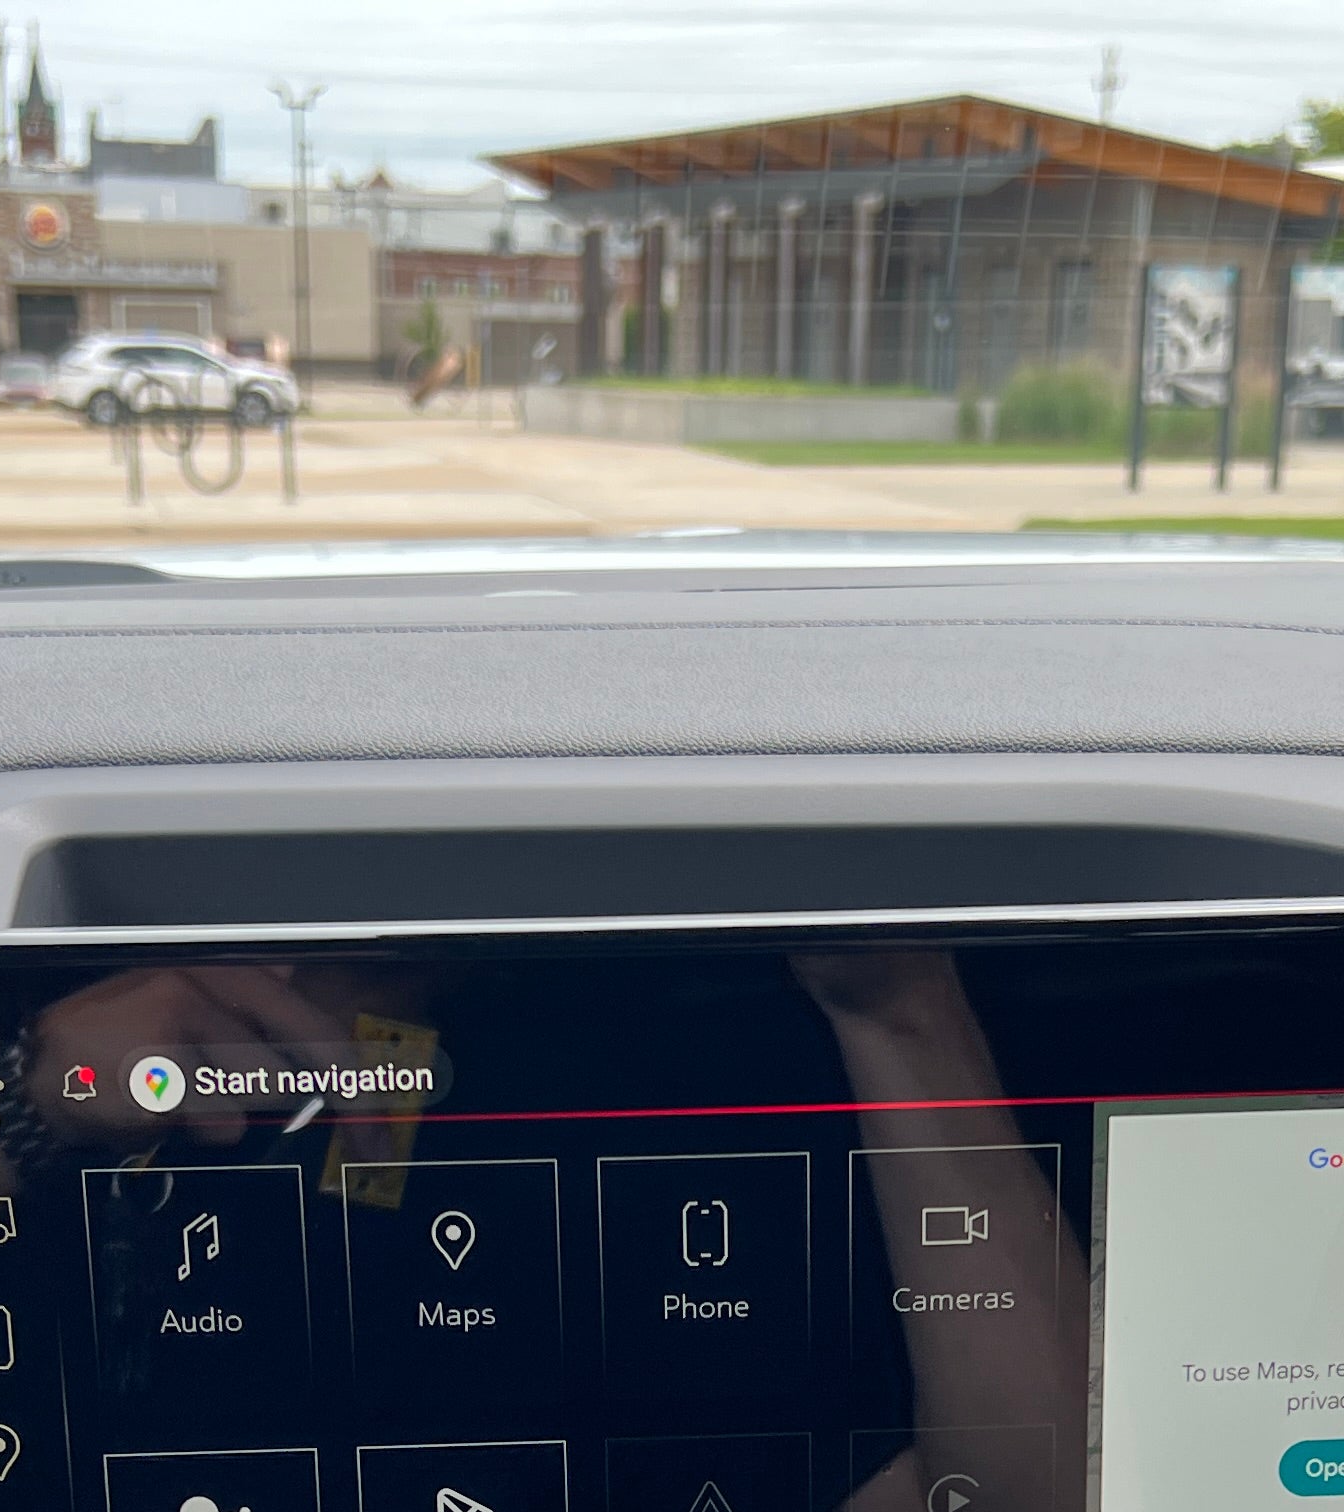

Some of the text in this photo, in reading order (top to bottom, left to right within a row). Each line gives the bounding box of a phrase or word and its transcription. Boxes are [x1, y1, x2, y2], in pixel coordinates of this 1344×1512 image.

[195, 1062, 433, 1099] Start navigation
[663, 1293, 750, 1320] Phone
[892, 1287, 1015, 1312] Cameras
[160, 1306, 243, 1334] Audio
[418, 1301, 496, 1332] Maps
[1181, 1363, 1207, 1383] To
[1212, 1366, 1251, 1382] use
[1257, 1361, 1320, 1384] Maps,
